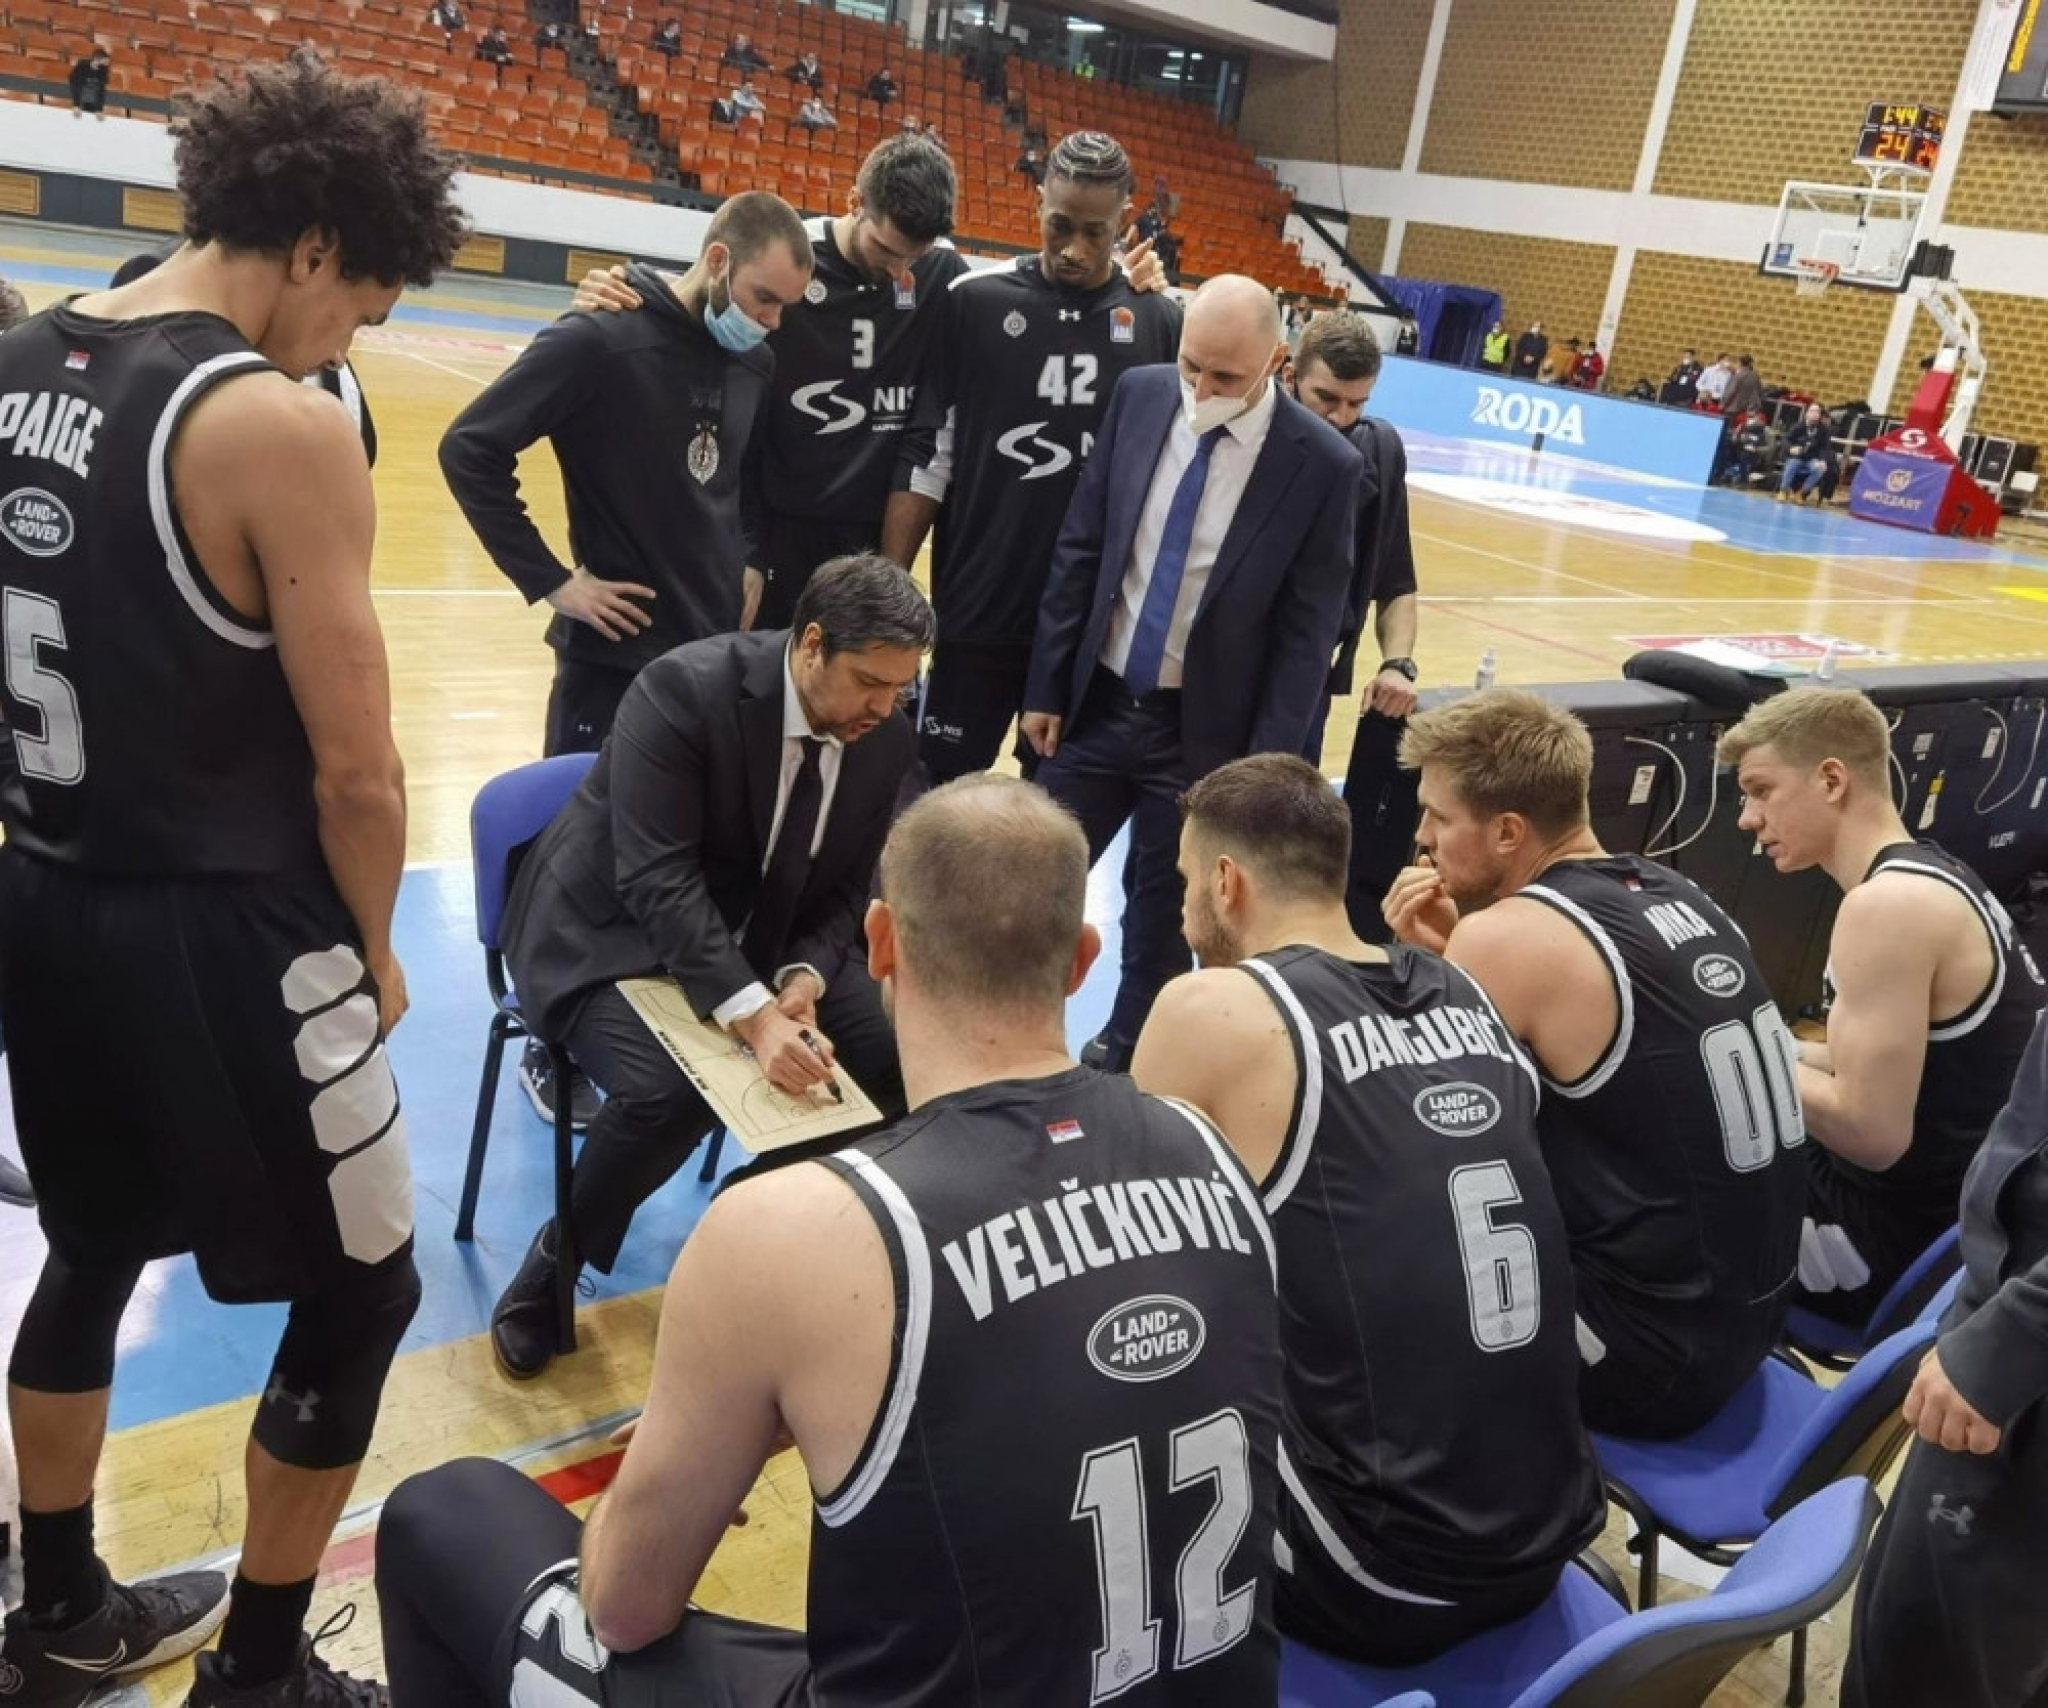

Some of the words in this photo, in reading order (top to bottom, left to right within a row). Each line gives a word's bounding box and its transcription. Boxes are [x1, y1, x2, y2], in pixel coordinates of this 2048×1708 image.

[1876, 134, 1910, 160] 24
[851, 318, 875, 370] 3
[1037, 353, 1098, 406] 42
[0, 391, 104, 479] PAIGE
[1470, 386, 1586, 444] RODA
[2, 585, 86, 786] 5
[1700, 999, 1807, 1174] 00
[941, 1169, 1252, 1322] VELIČKOVIĆ
[1448, 1158, 1541, 1353] 6
[1113, 1309, 1168, 1345] LAND
[1124, 1328, 1189, 1367] ROVER
[1070, 1406, 1258, 1707] 12
